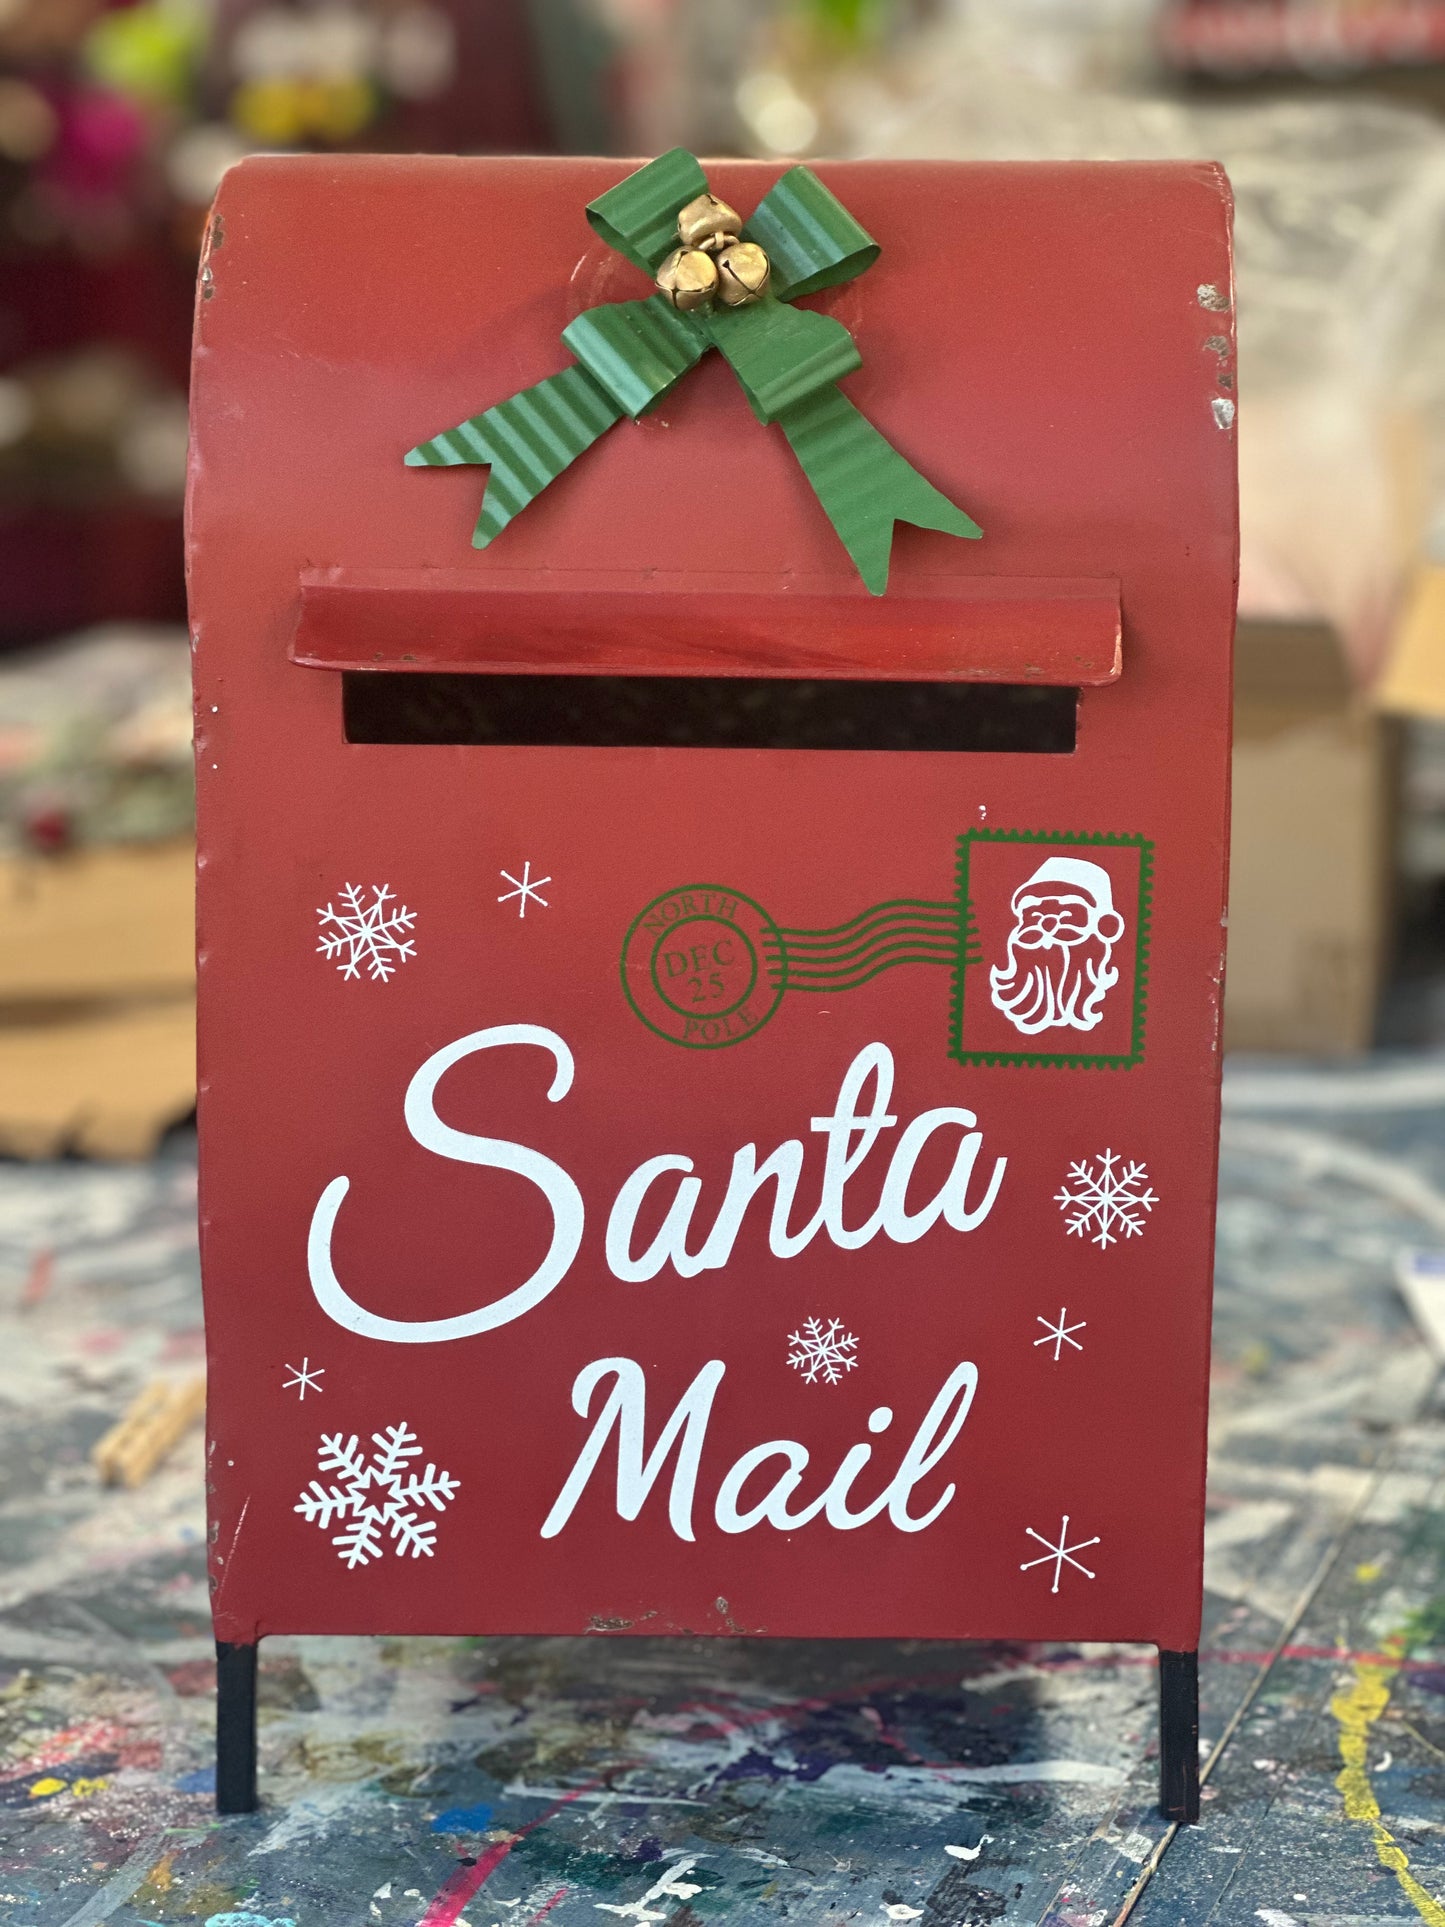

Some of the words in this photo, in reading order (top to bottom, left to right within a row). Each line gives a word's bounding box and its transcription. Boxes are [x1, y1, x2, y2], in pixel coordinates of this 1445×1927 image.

[642, 892, 738, 938] NORTH
[663, 938, 735, 978] DEC
[687, 972, 725, 1003] 25
[682, 1005, 758, 1041] POLE
[307, 1023, 1008, 1343] Santa
[540, 1356, 978, 1542] Mail
